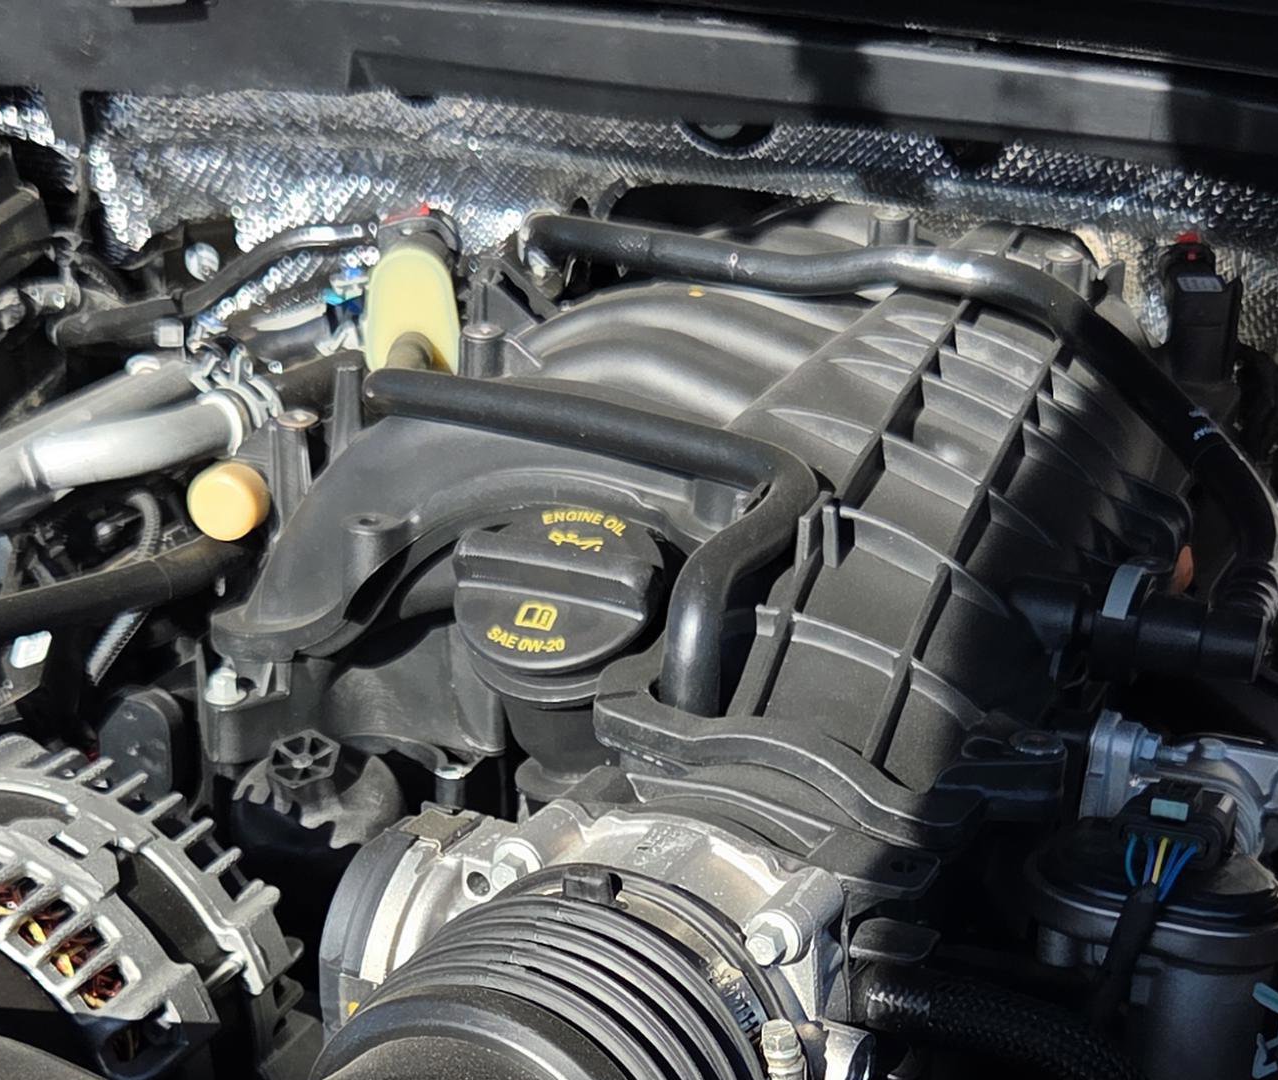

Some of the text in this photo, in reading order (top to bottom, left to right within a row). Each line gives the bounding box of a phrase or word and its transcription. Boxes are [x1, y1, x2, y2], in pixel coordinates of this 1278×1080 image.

[541, 508, 627, 537] ENGINE OIL
[485, 624, 566, 653] SAE 0W-20
